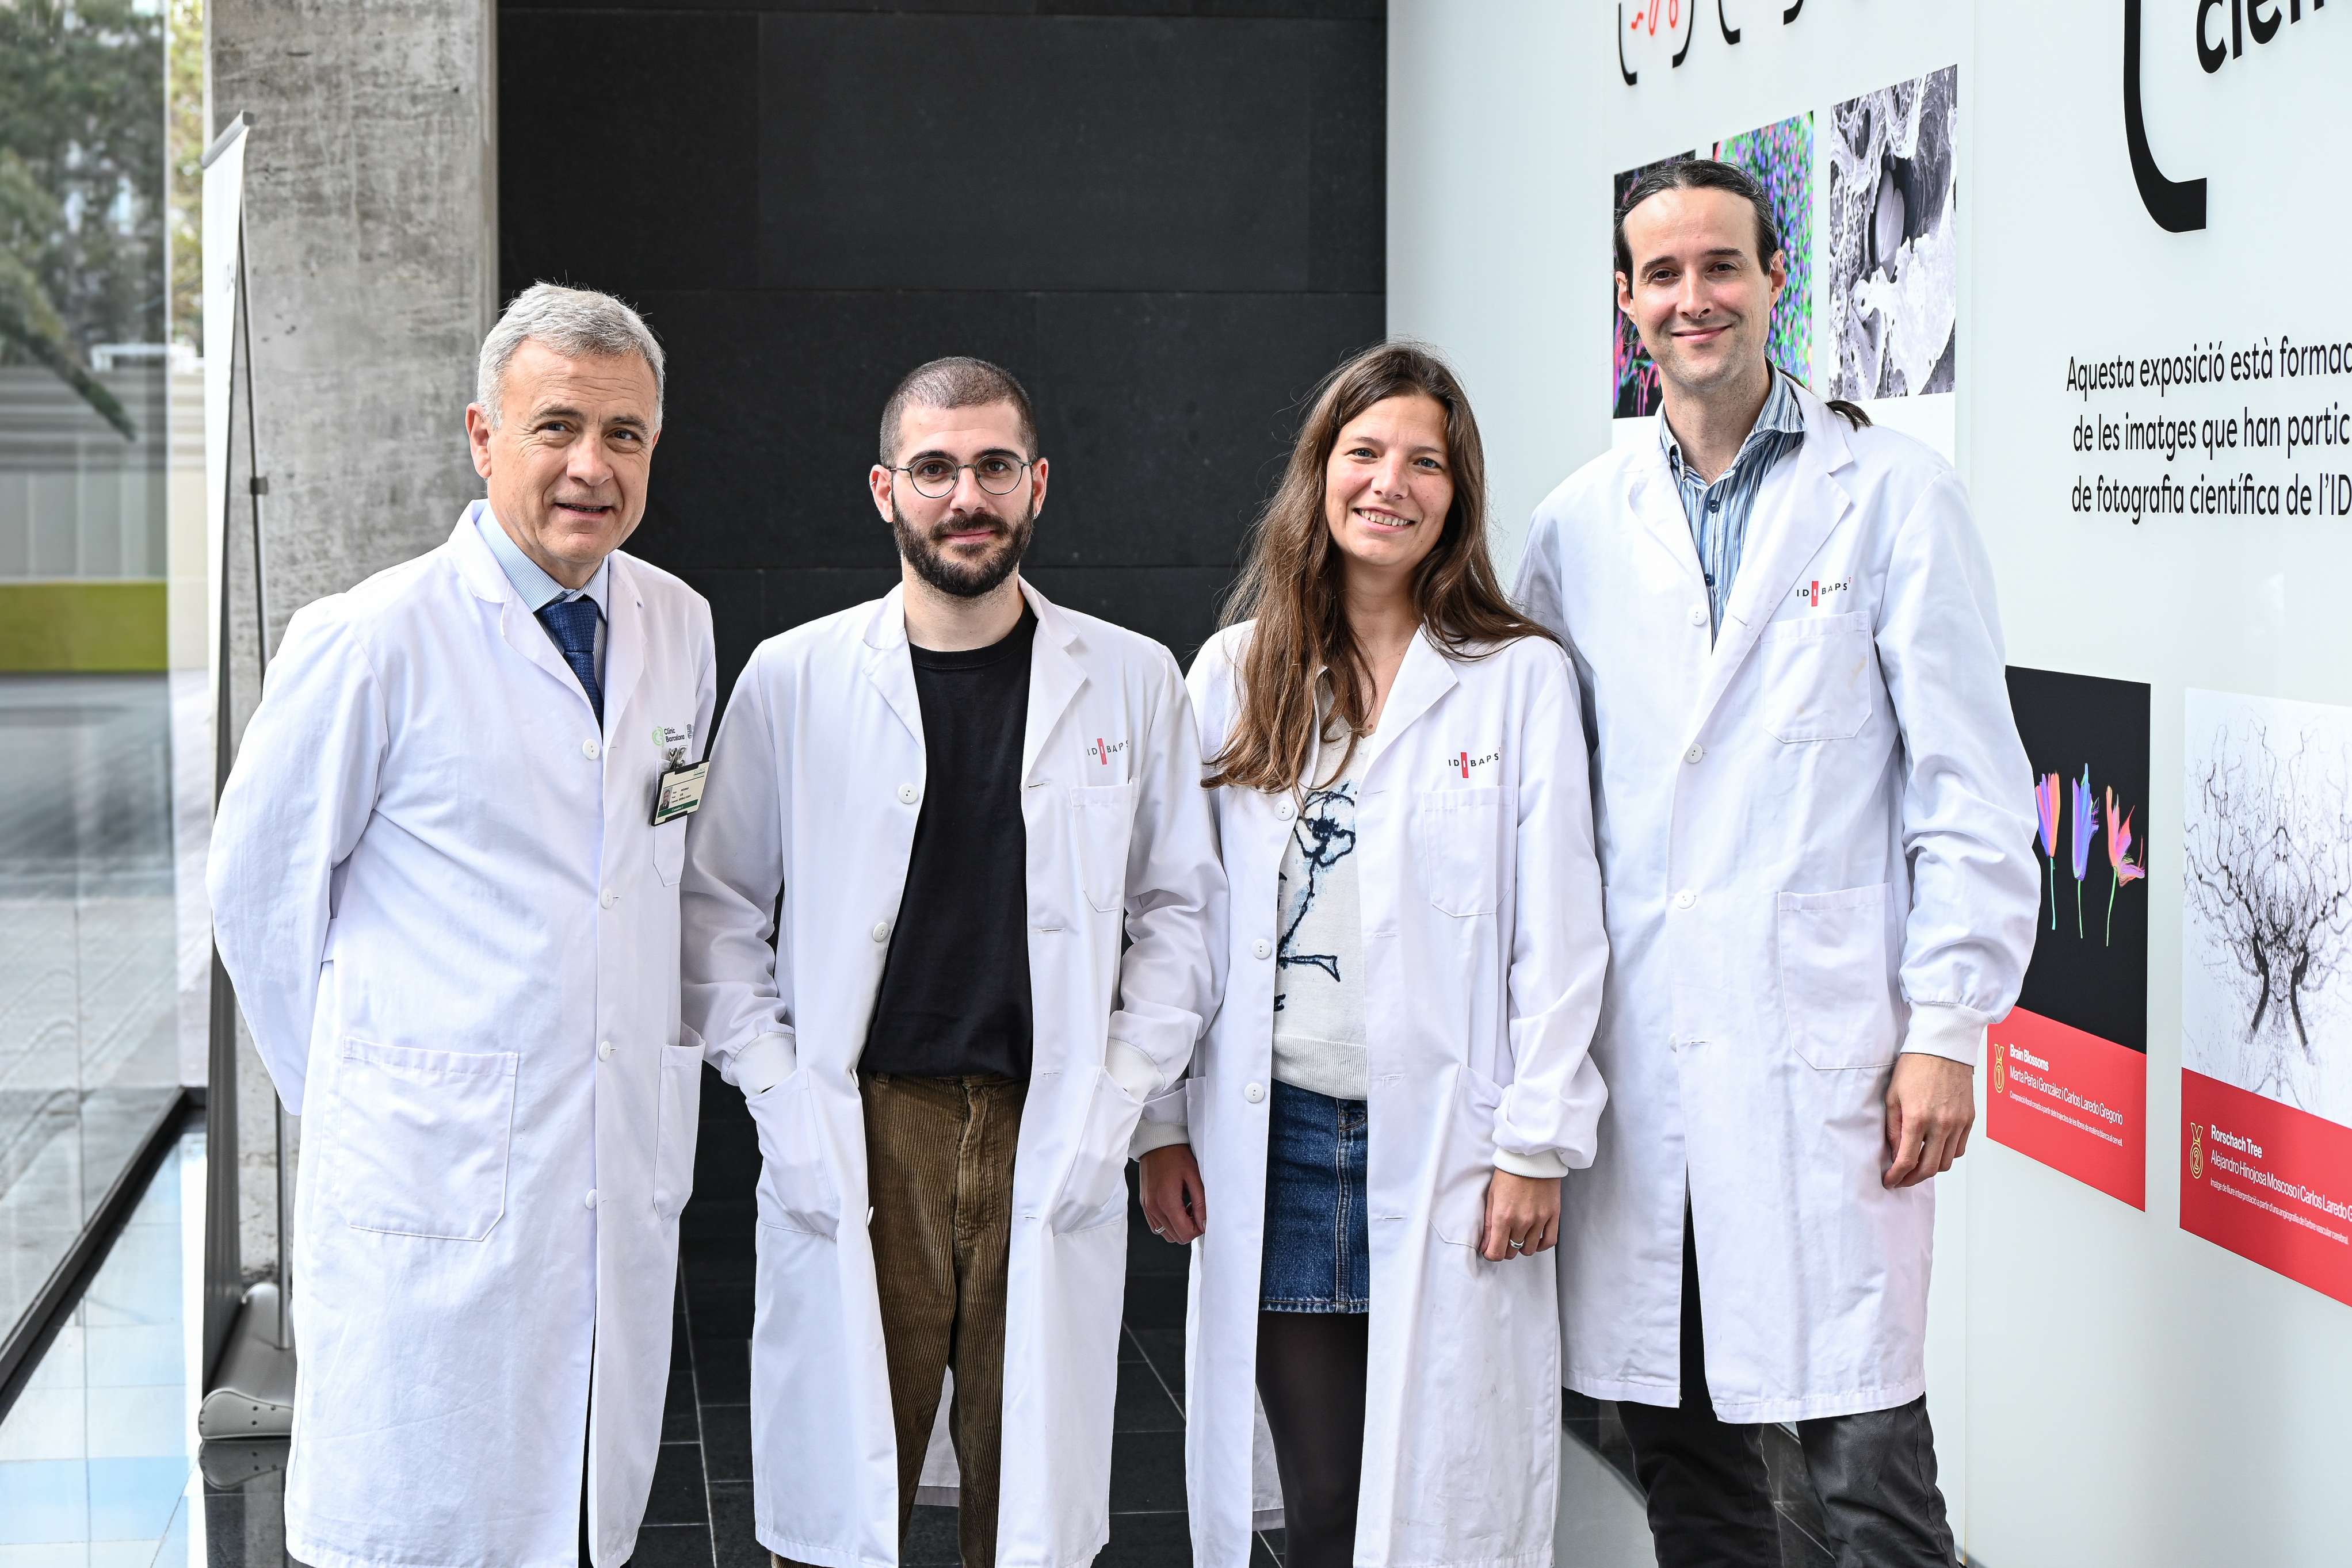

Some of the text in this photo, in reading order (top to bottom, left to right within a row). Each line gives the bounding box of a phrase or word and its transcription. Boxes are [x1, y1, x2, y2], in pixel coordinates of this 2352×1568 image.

[2067, 354, 2135, 402] Aquesta
[2140, 341, 2224, 397] exposició
[2231, 336, 2273, 381] està
[2074, 414, 2093, 452] de
[2098, 413, 2120, 452] les
[2125, 411, 2197, 462] imatges
[2202, 417, 2238, 461] que
[2244, 406, 2281, 448] han
[2072, 475, 2092, 513] de
[2097, 473, 2184, 525] fotografia
[2190, 473, 2280, 515] científica
[2286, 473, 2312, 516] de
[665, 734, 685, 742] Barcelona
[2010, 1043, 2049, 1072] Brain Blossoms
[2010, 1065, 2024, 1084] Marta
[2024, 1070, 2037, 1088] Peña
[2038, 1077, 2061, 1099] González
[2064, 1087, 2080, 1107] Carlos
[2080, 1095, 2099, 1115] Laredo
[2099, 1103, 2123, 1125] Gregorio
[2211, 1124, 2263, 1158] Rorschach Tree
[2210, 1149, 2239, 1175] Alejandro
[2239, 1160, 2266, 1186] Hinojosa
[2267, 1172, 2297, 1199] Moscoso
[2297, 1184, 2300, 1199] i
[2300, 1185, 2322, 1210] Carlos
[2322, 1194, 2347, 1219] Laredo
